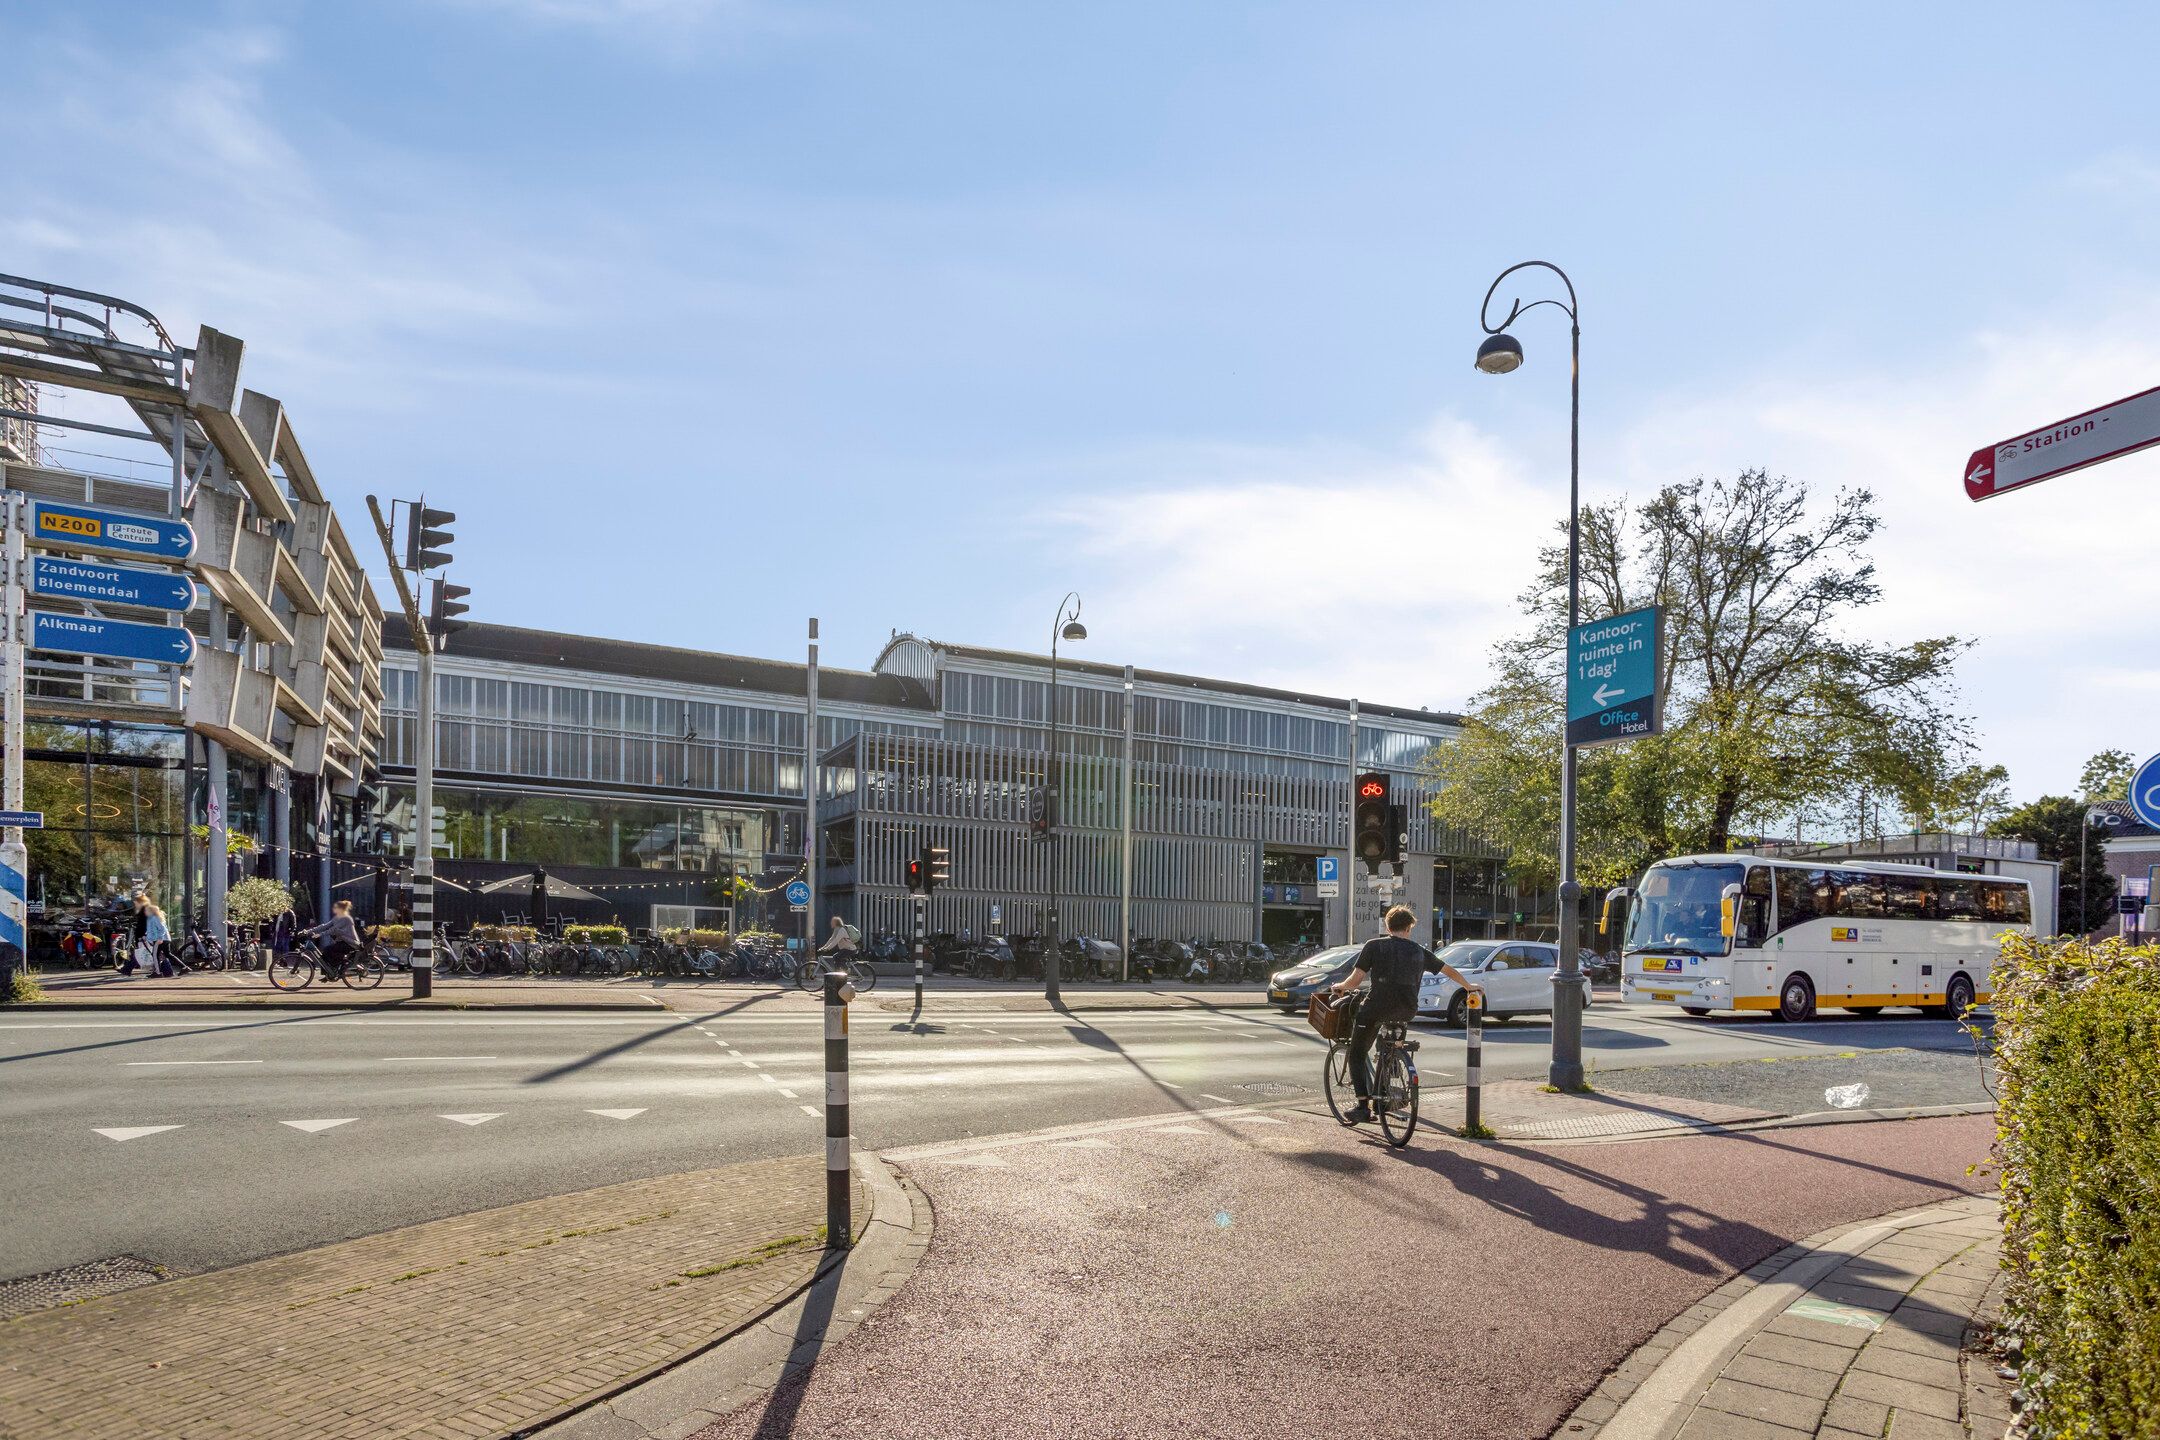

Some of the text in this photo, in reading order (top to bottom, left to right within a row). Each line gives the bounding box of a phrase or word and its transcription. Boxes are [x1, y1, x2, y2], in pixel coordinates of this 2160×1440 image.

[2023, 420, 2095, 453] Station
[44, 515, 97, 534] N200
[112, 531, 153, 544] Centrum
[39, 562, 120, 582] Zandvoort
[39, 577, 139, 599] Bloemendaal
[39, 617, 105, 634] Alkmaar
[1580, 622, 1642, 646] Kantoor-
[1579, 638, 1643, 663] ruimte in
[1579, 658, 1617, 680] 1 dag!
[1600, 710, 1639, 727] Office
[1621, 719, 1648, 734] Hotel
